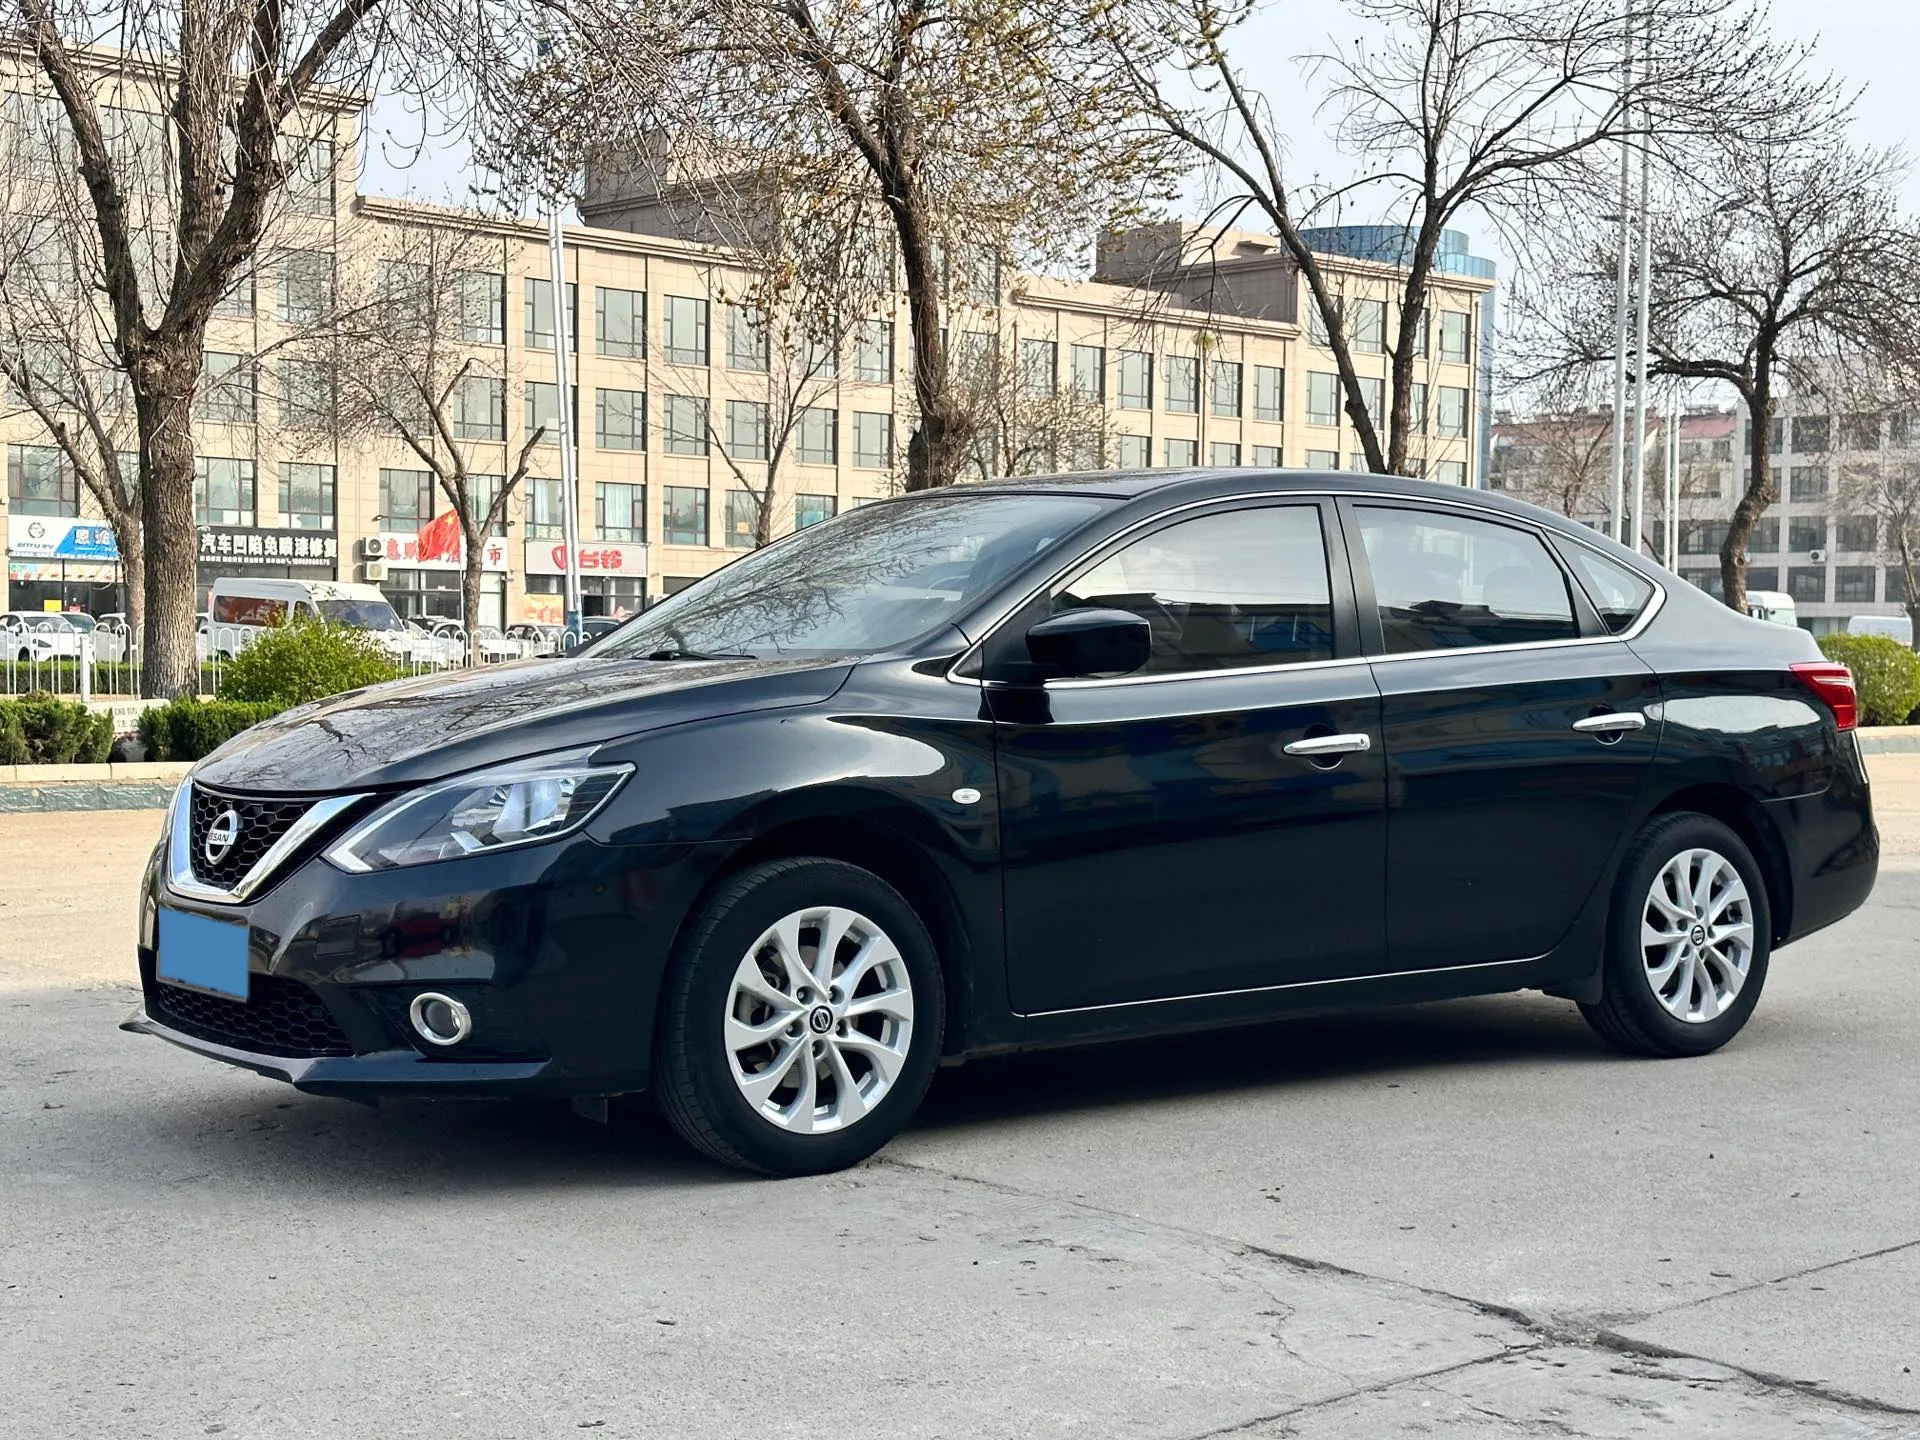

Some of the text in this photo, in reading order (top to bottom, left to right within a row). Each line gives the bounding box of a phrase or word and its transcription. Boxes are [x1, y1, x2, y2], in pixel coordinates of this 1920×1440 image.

[200, 532, 338, 558] 汽车凹陷免喷漆修复
[207, 832, 230, 843] ISSAN
